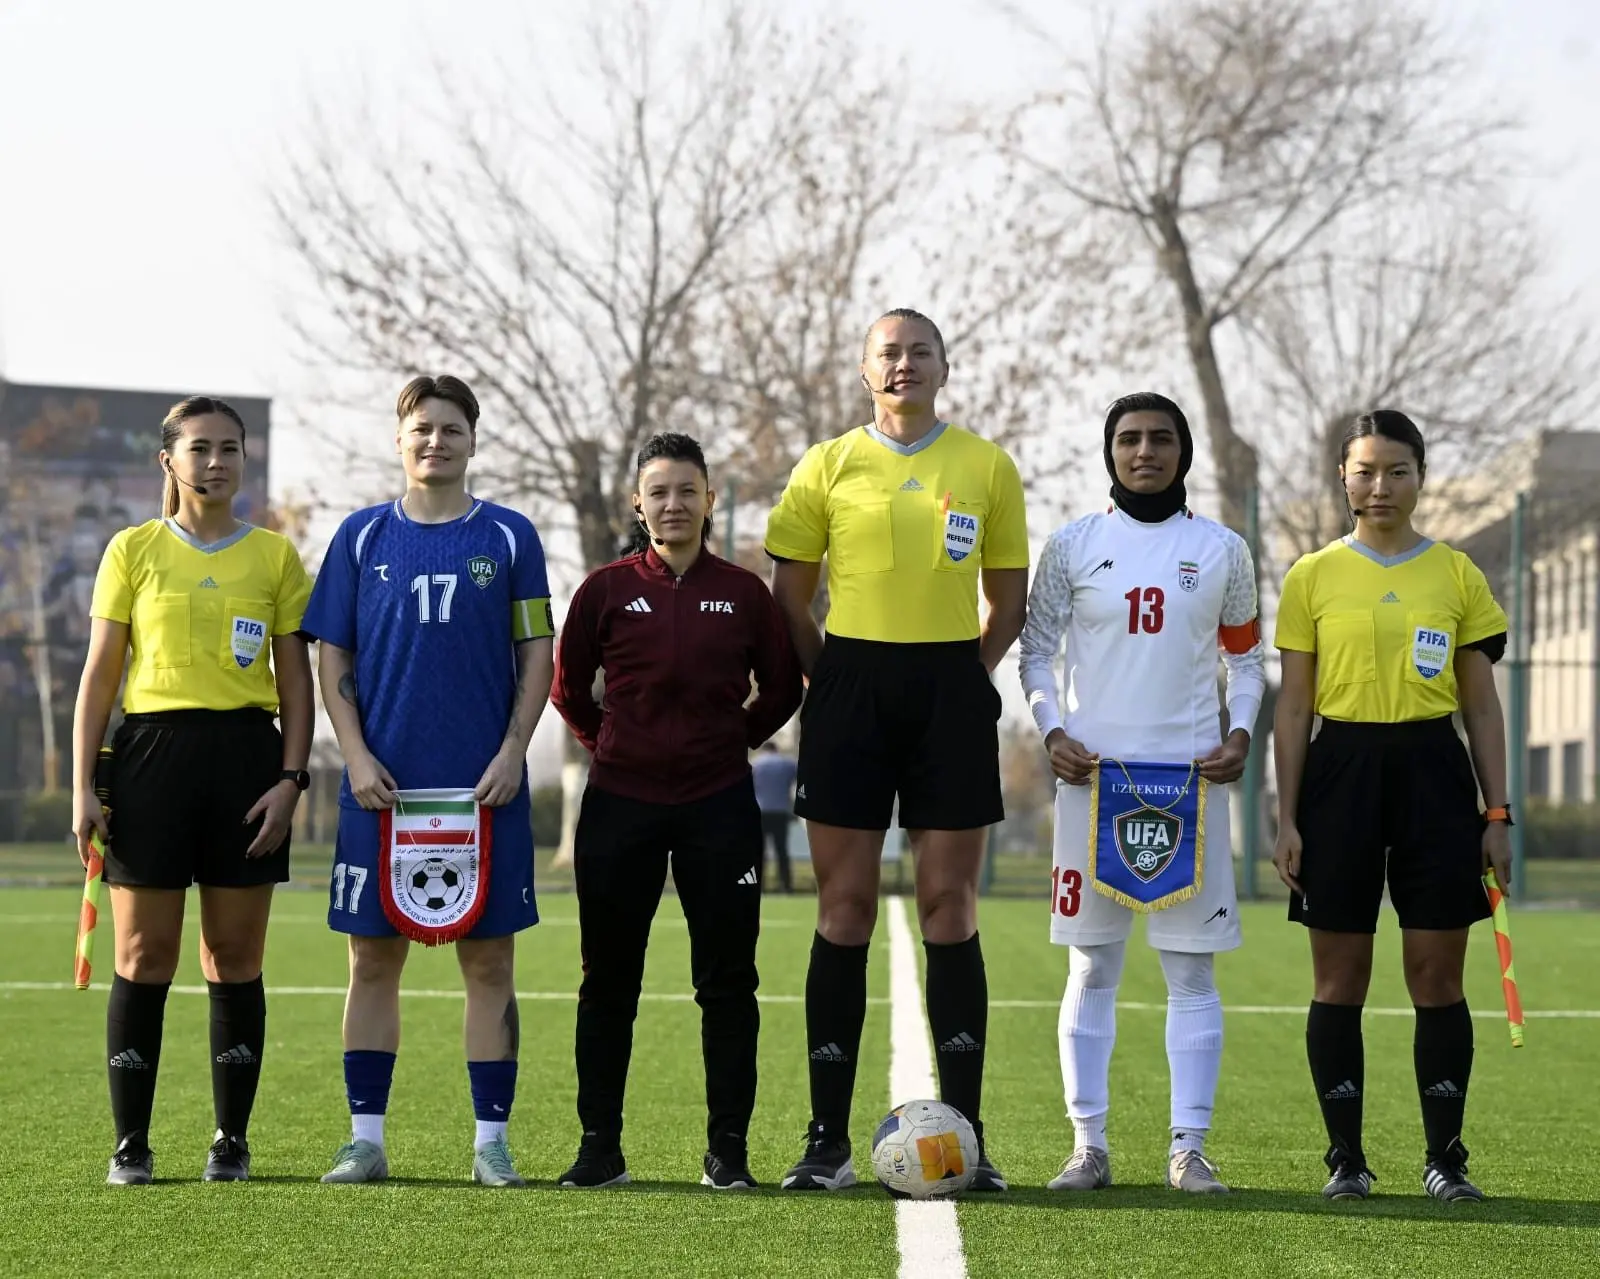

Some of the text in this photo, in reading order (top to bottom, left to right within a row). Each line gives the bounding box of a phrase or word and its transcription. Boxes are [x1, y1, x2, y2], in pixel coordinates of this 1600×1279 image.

[948, 513, 975, 531] FIFA
[946, 533, 974, 544] REFEREE
[471, 562, 492, 575] UFA
[411, 574, 458, 623] 17
[700, 601, 733, 613] FIFA
[1124, 587, 1165, 635] 13
[236, 620, 263, 637] FIFA
[1417, 630, 1447, 647] FIFA
[1126, 822, 1170, 847] UFA
[395, 855, 403, 890] FOOTBALL
[469, 872, 477, 882] OF
[333, 863, 368, 914] 17
[1052, 866, 1082, 917] 13
[456, 883, 475, 914] REPUBLIC
[397, 891, 429, 924] FEDERATION
[429, 911, 459, 925] ISLAMIC
[811, 1050, 849, 1062] adidas
[940, 1043, 981, 1052] adidas
[110, 1055, 149, 1069] adidas
[216, 1053, 257, 1064] adidas
[894, 1150, 909, 1179] AFC
